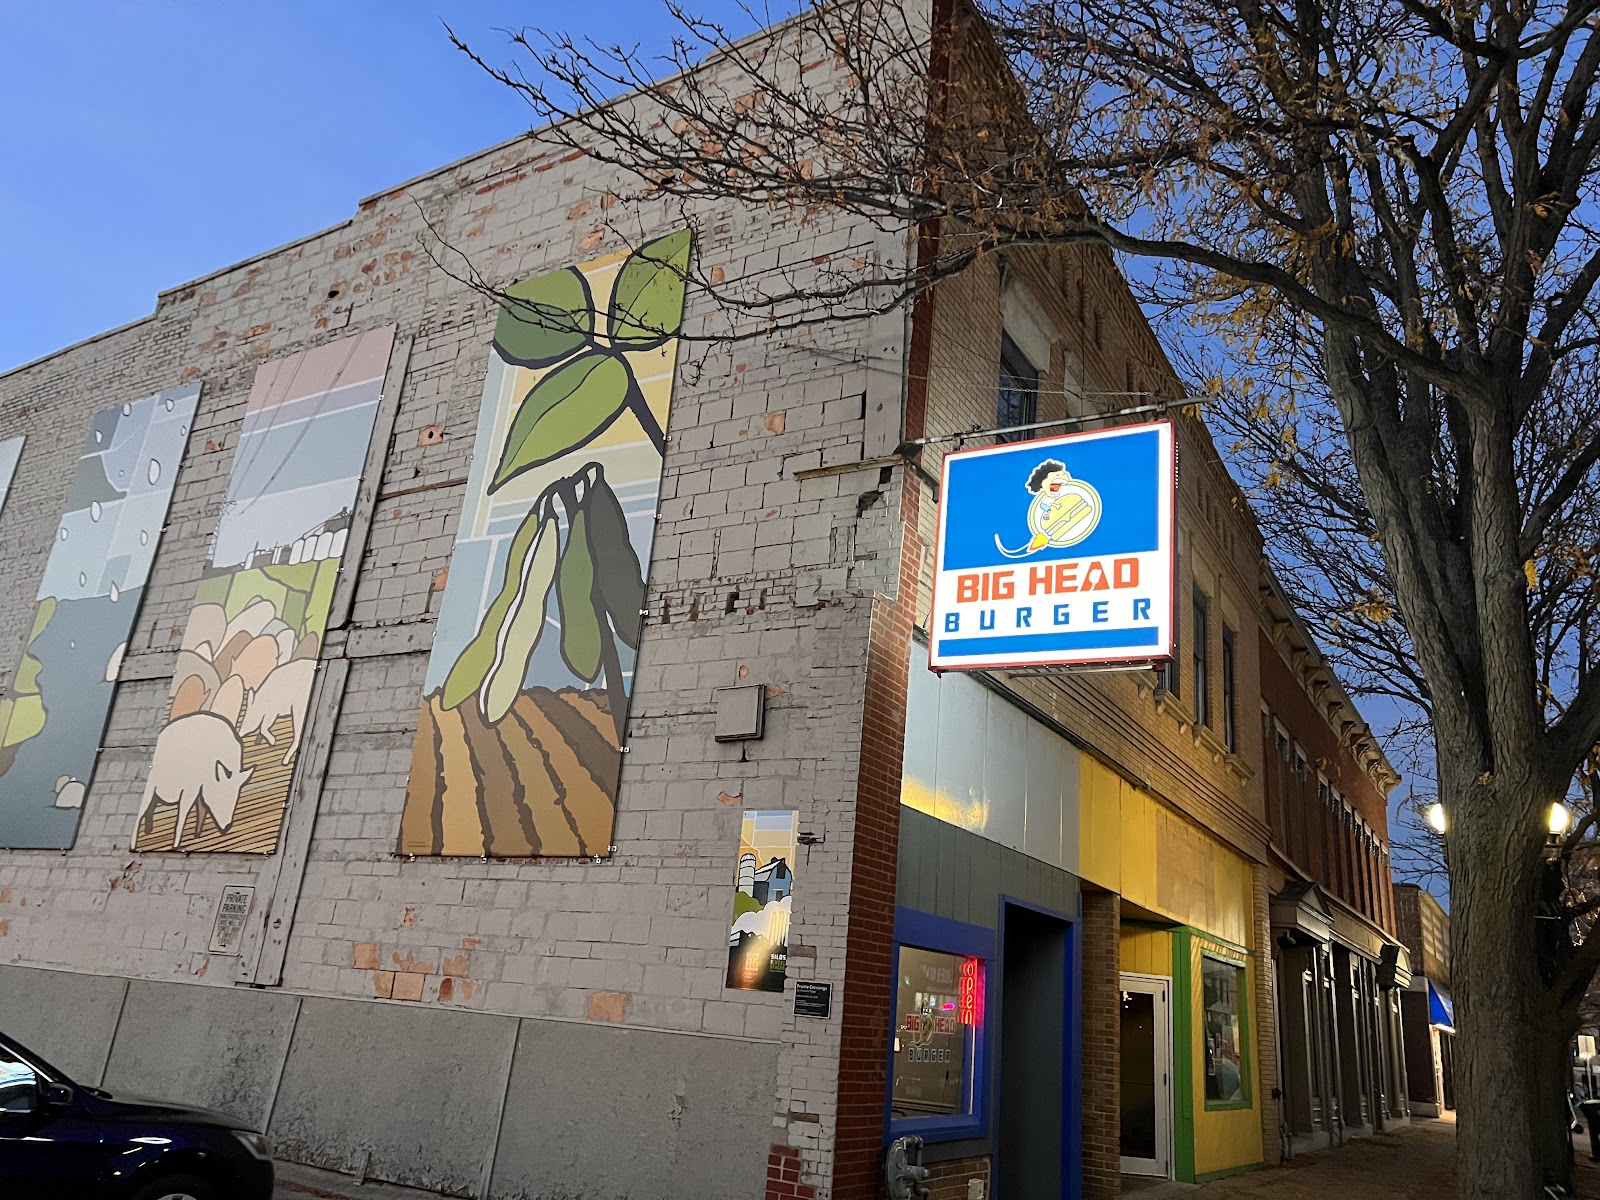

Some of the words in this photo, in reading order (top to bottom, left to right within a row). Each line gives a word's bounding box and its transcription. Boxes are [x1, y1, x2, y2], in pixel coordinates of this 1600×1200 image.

[956, 570, 1015, 603] BIG
[1028, 557, 1139, 596] HEAD
[944, 597, 1151, 633] BURGER
[226, 894, 248, 903] PRIVATE
[222, 904, 246, 913] PARKING
[905, 1013, 921, 1033] BIG
[934, 1015, 956, 1035] HEAD
[908, 1047, 951, 1062] BURGER
